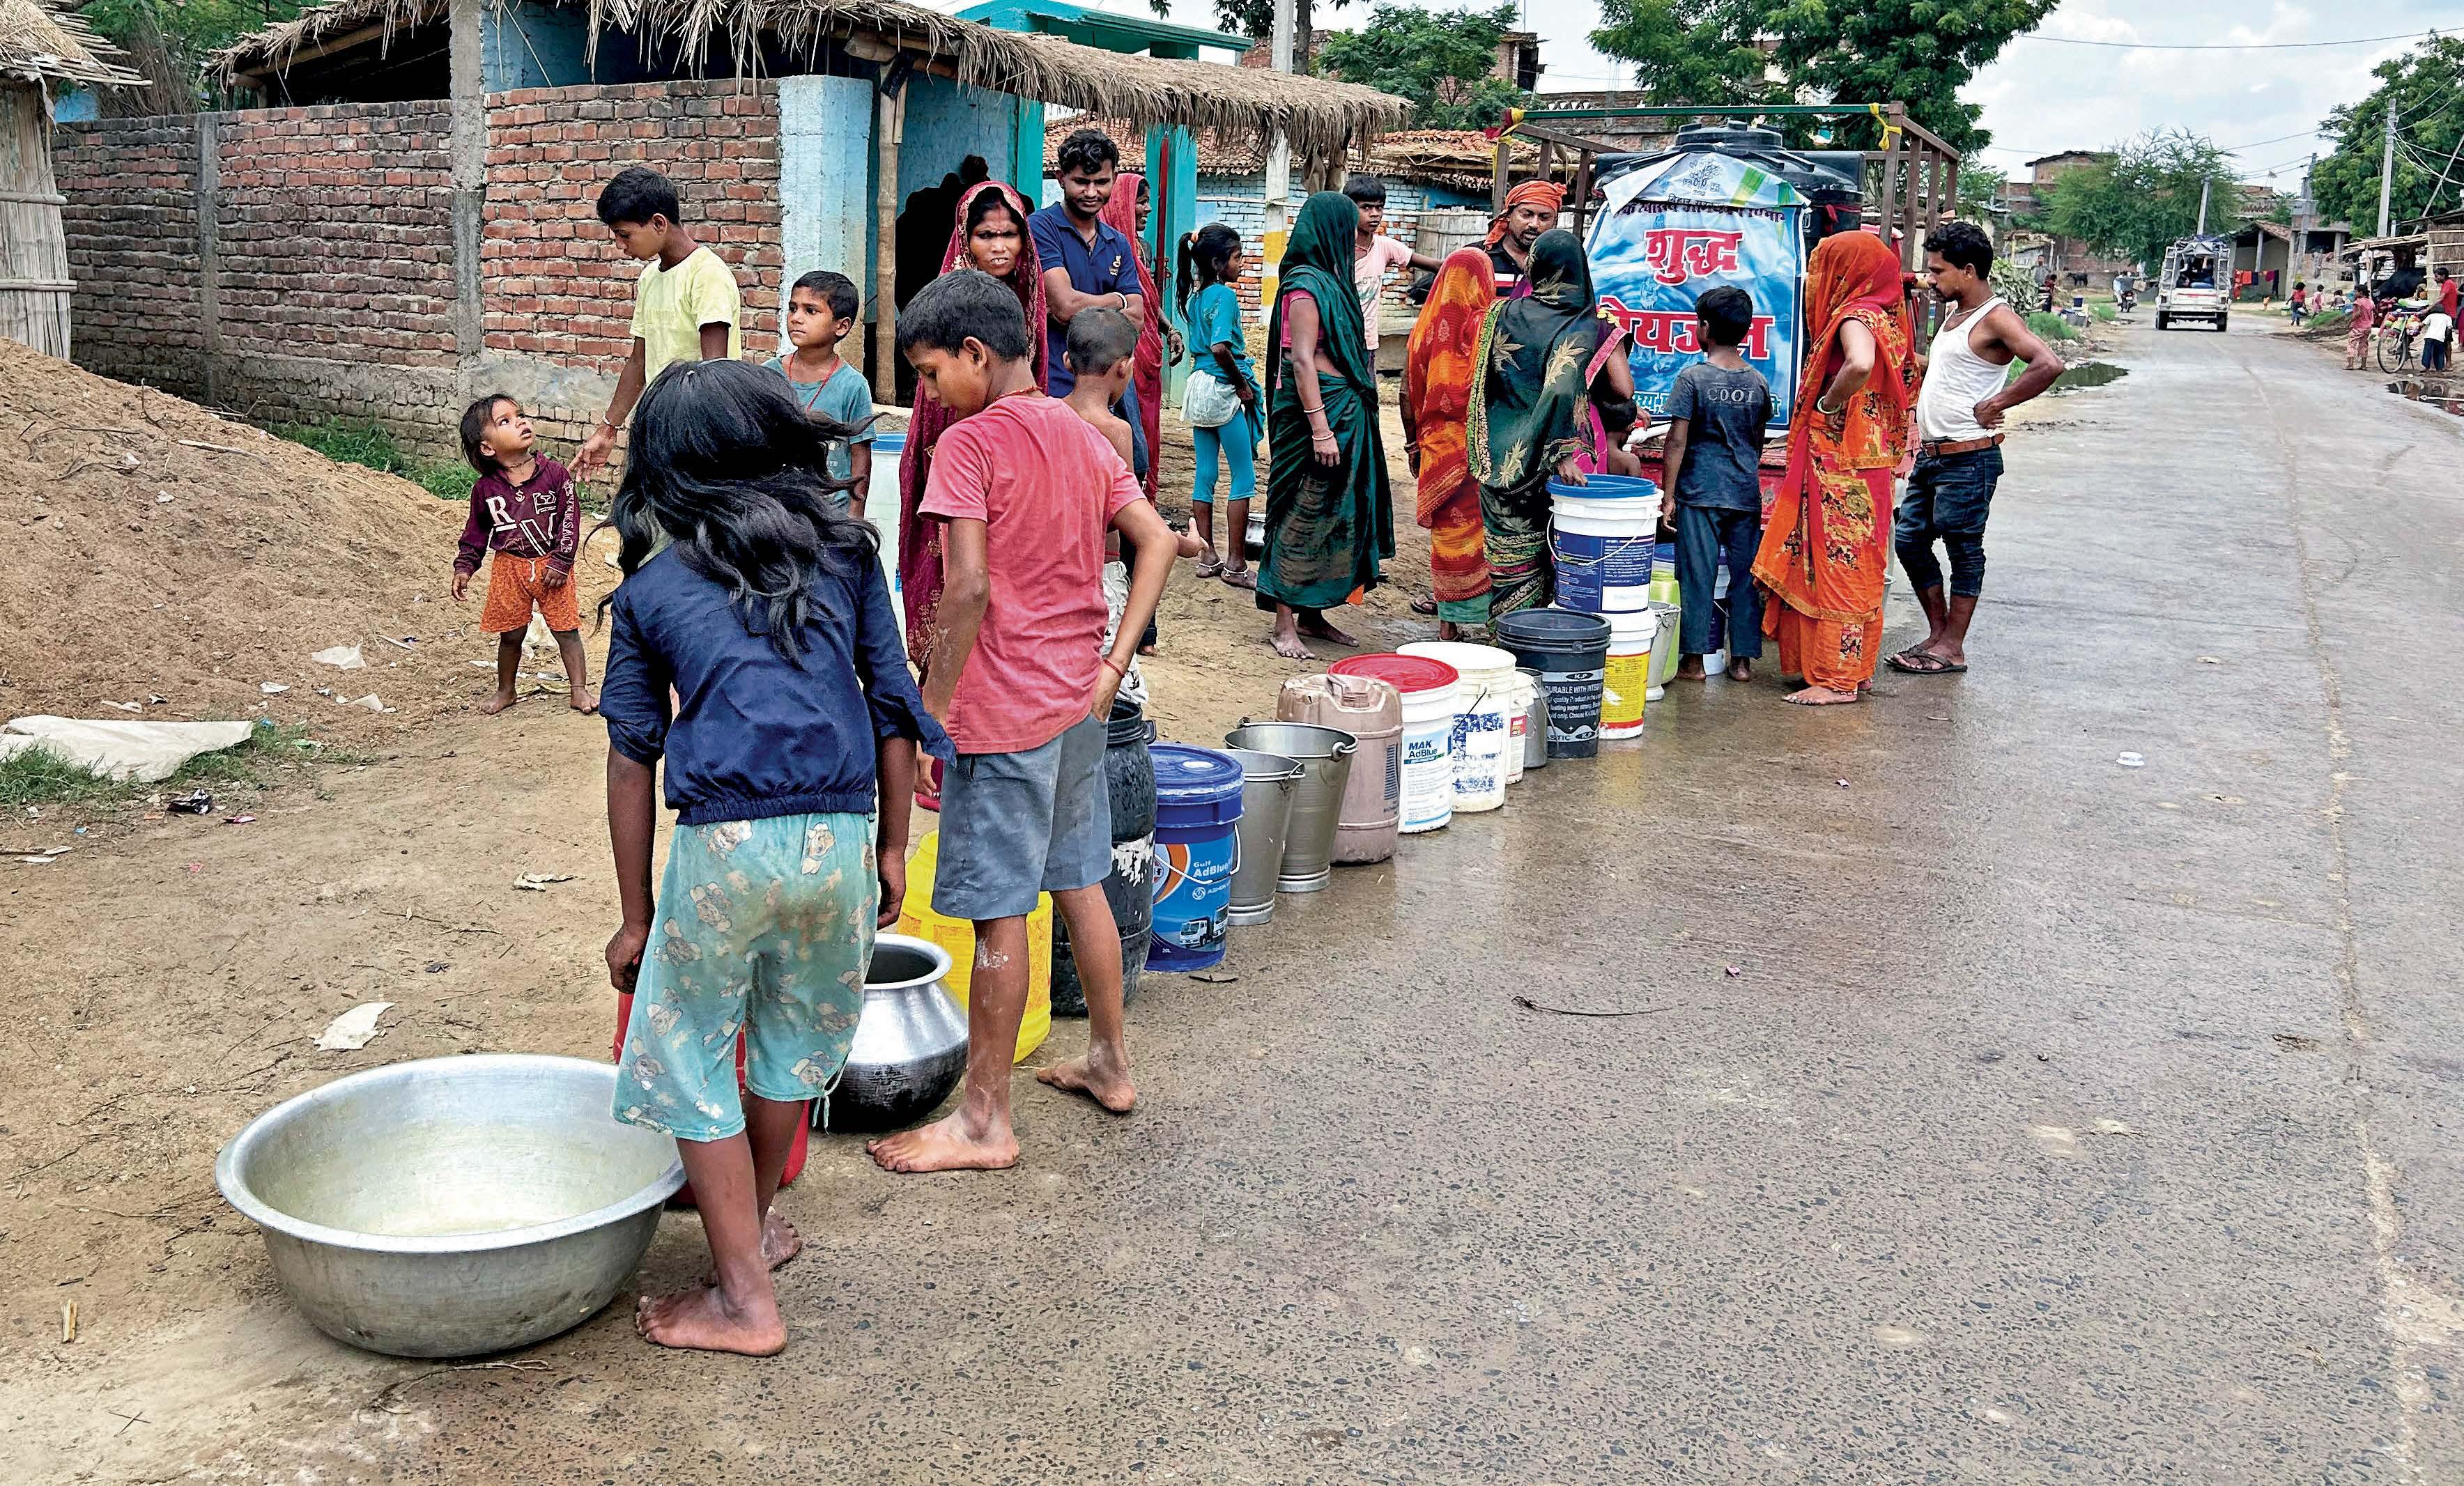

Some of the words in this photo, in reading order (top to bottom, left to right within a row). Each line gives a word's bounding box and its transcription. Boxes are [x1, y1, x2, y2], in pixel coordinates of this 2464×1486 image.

[1645, 227, 1744, 286] शुद्ध
[1408, 740, 1433, 751] MAK
[1408, 748, 1438, 759] AdBlue
[1193, 860, 1211, 868] Gulf
[1192, 862, 1229, 878] AdBlue
